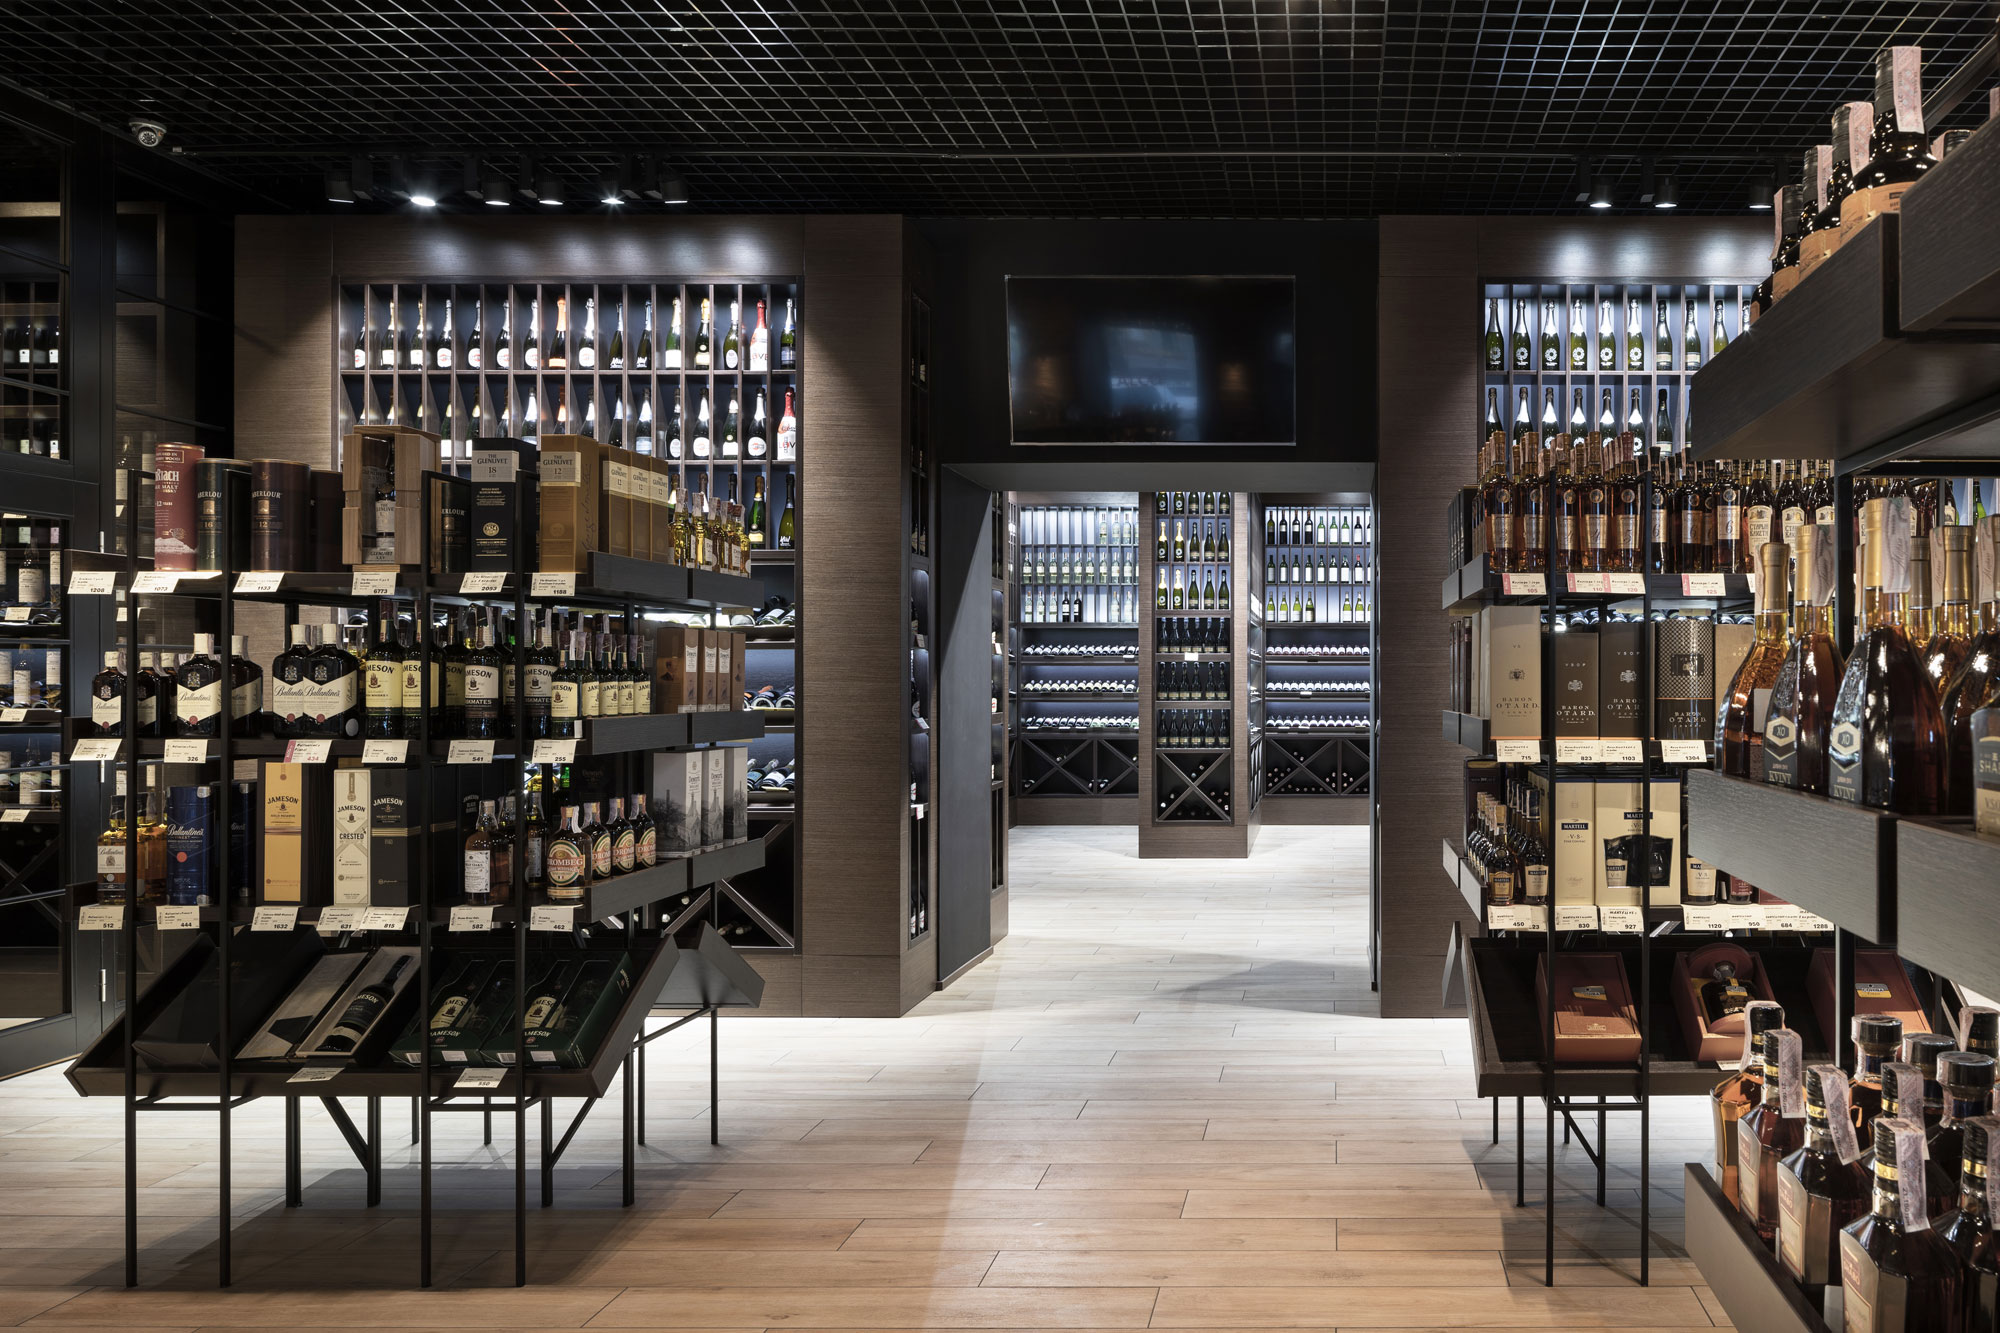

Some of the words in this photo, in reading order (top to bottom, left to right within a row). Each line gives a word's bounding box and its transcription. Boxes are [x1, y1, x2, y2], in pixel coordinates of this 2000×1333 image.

[477, 458, 509, 466] GLENLIVET
[488, 466, 498, 474] 18
[611, 470, 628, 478] GLENLIVET
[632, 475, 648, 483] GLENLIVET
[198, 491, 221, 499] ABERLOU
[442, 508, 465, 516] ERLOUR
[366, 664, 394, 675] MESON
[466, 669, 493, 679] MESON
[275, 685, 304, 697] Ballantin
[305, 685, 341, 697] Ballantine's
[552, 684, 573, 692] MESON
[179, 690, 211, 702] Ballantine's
[1777, 726, 1786, 736] XO
[1841, 735, 1851, 745] XO
[1979, 759, 2000, 774] SHA
[267, 795, 299, 805] JAMESON
[372, 796, 404, 807] JAMESON
[338, 804, 366, 813] JAMESON
[168, 823, 205, 836] Ballantine's
[339, 832, 365, 840] CRESTED
[637, 843, 656, 854] DROM
[592, 851, 611, 861] DROM
[357, 993, 379, 1004] MESON
[524, 1030, 552, 1039] AMESON
